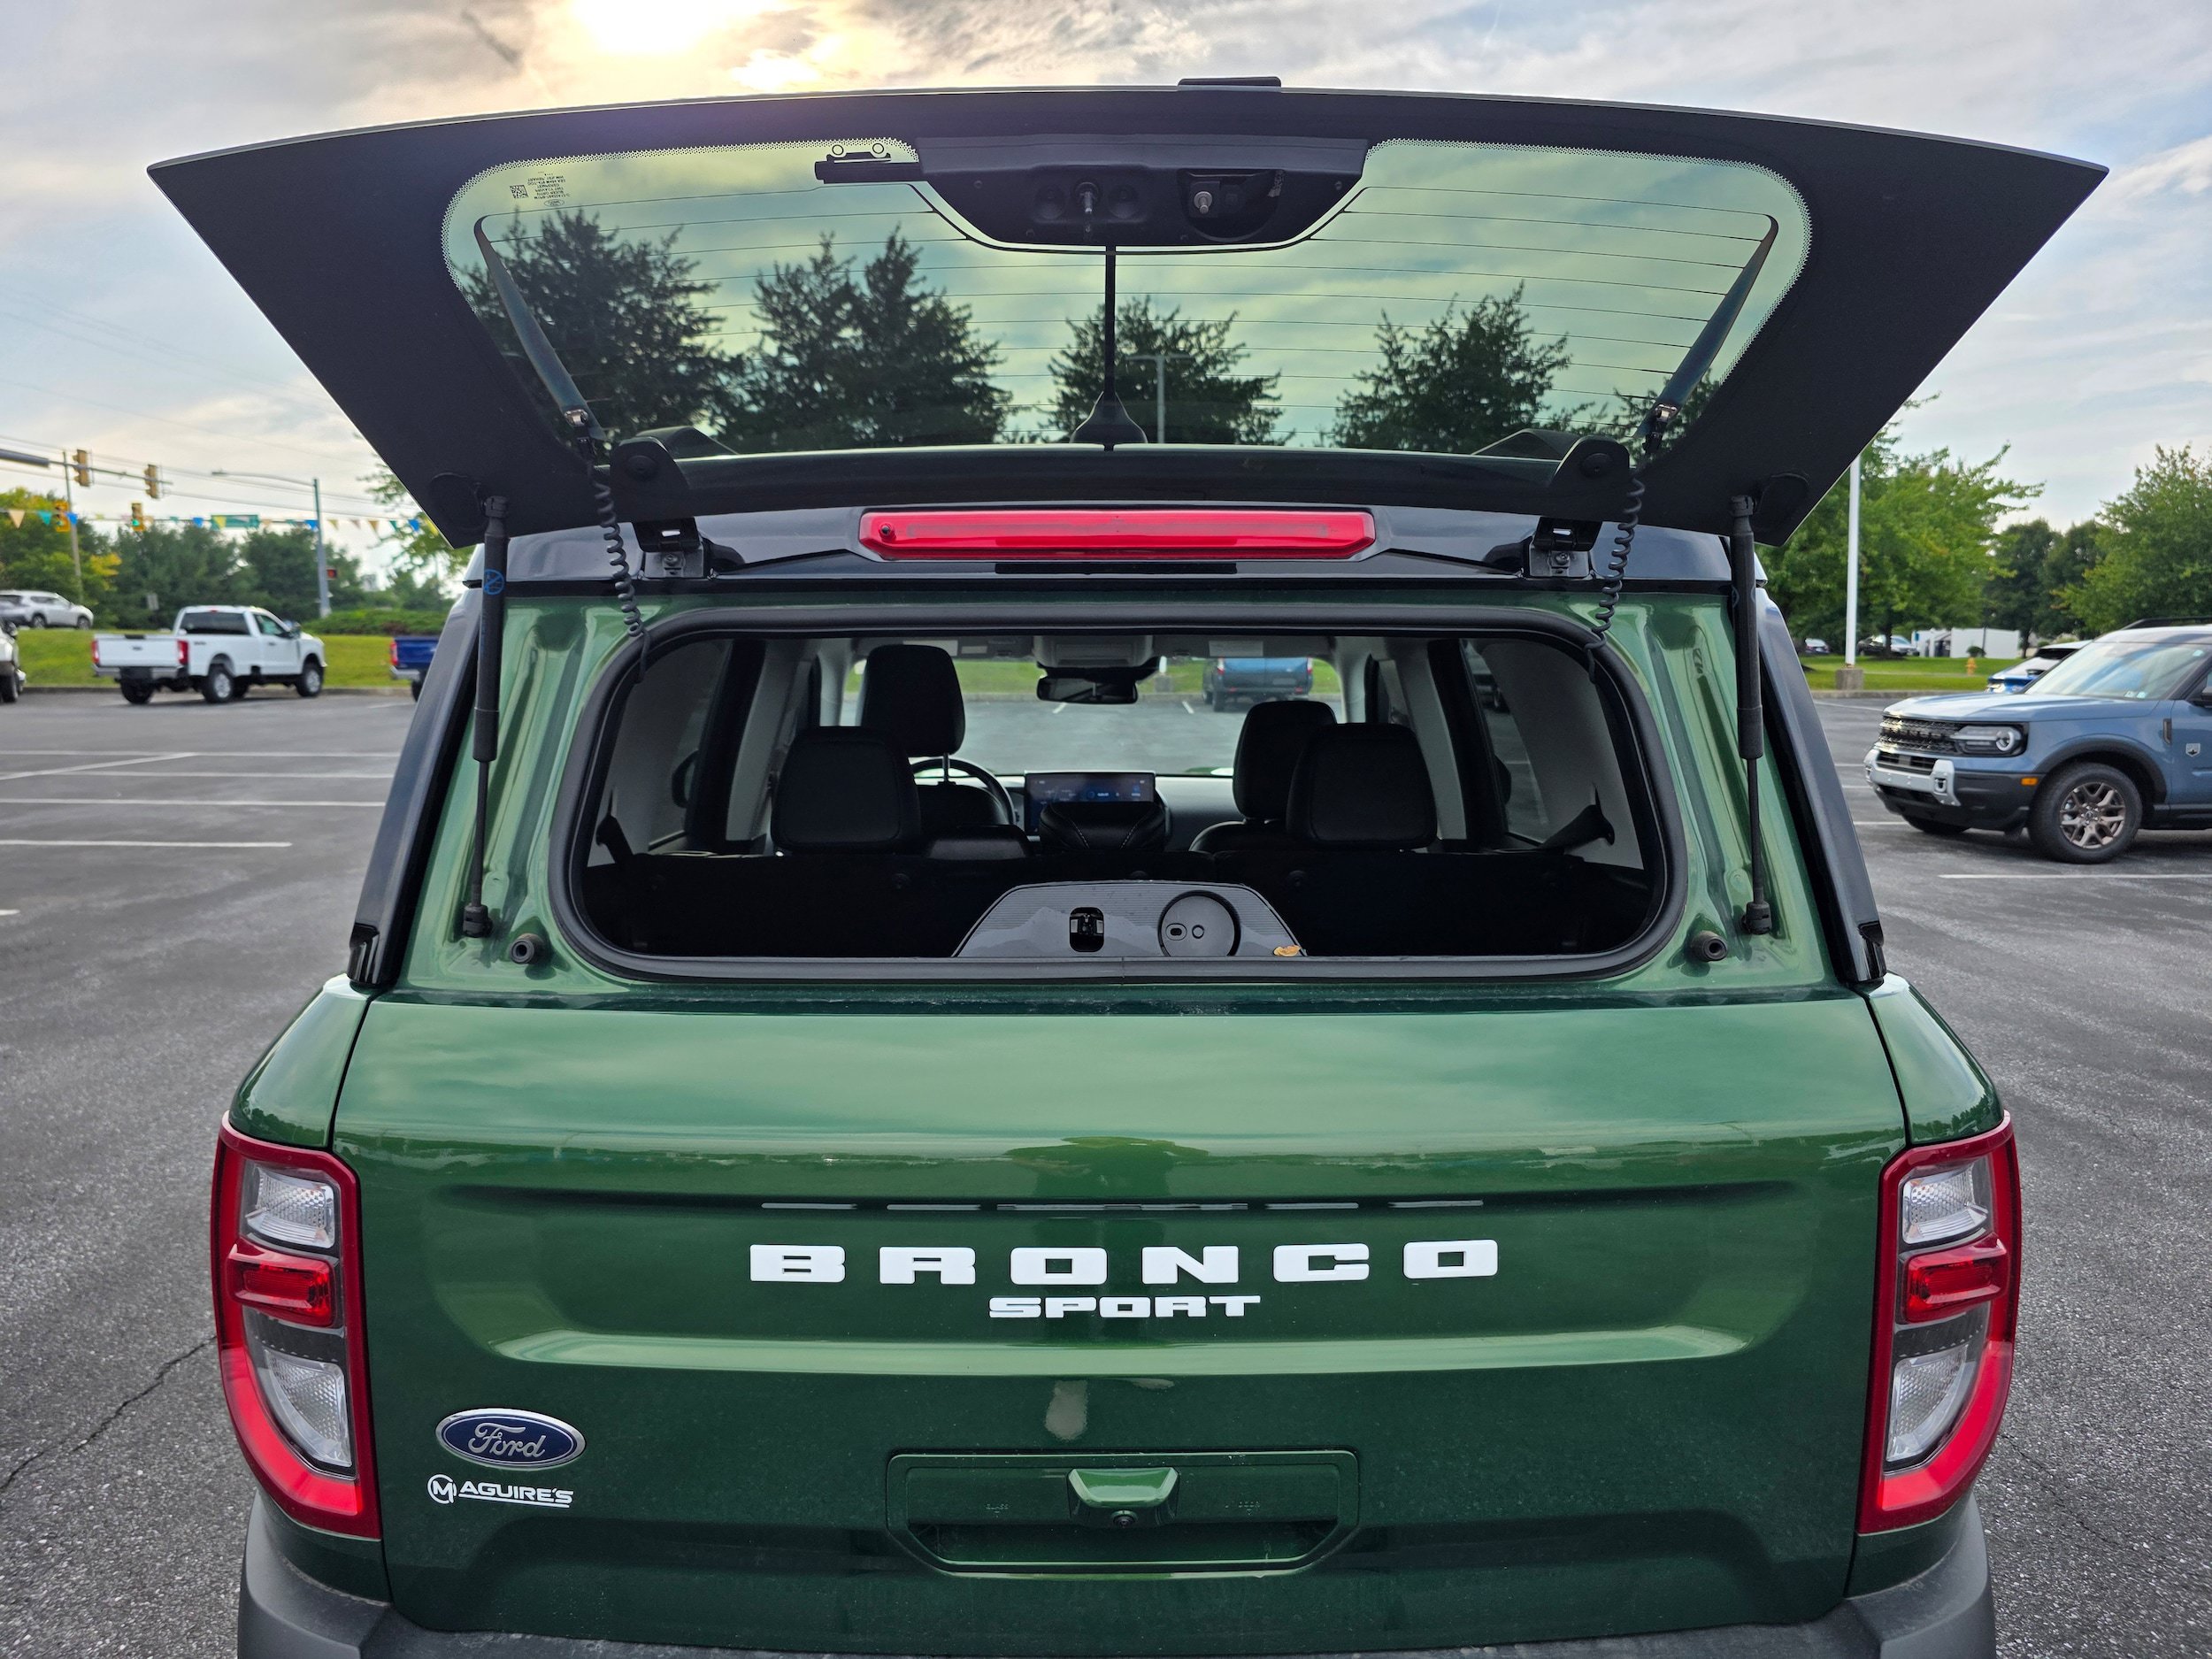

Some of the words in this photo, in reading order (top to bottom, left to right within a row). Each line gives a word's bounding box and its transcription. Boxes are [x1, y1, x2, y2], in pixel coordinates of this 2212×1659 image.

[750, 1240, 1497, 1284] BRONCO
[990, 1295, 1260, 1317] SPORT
[467, 1422, 548, 1458] Ford
[427, 1474, 573, 1508] MAGUIRE'S
